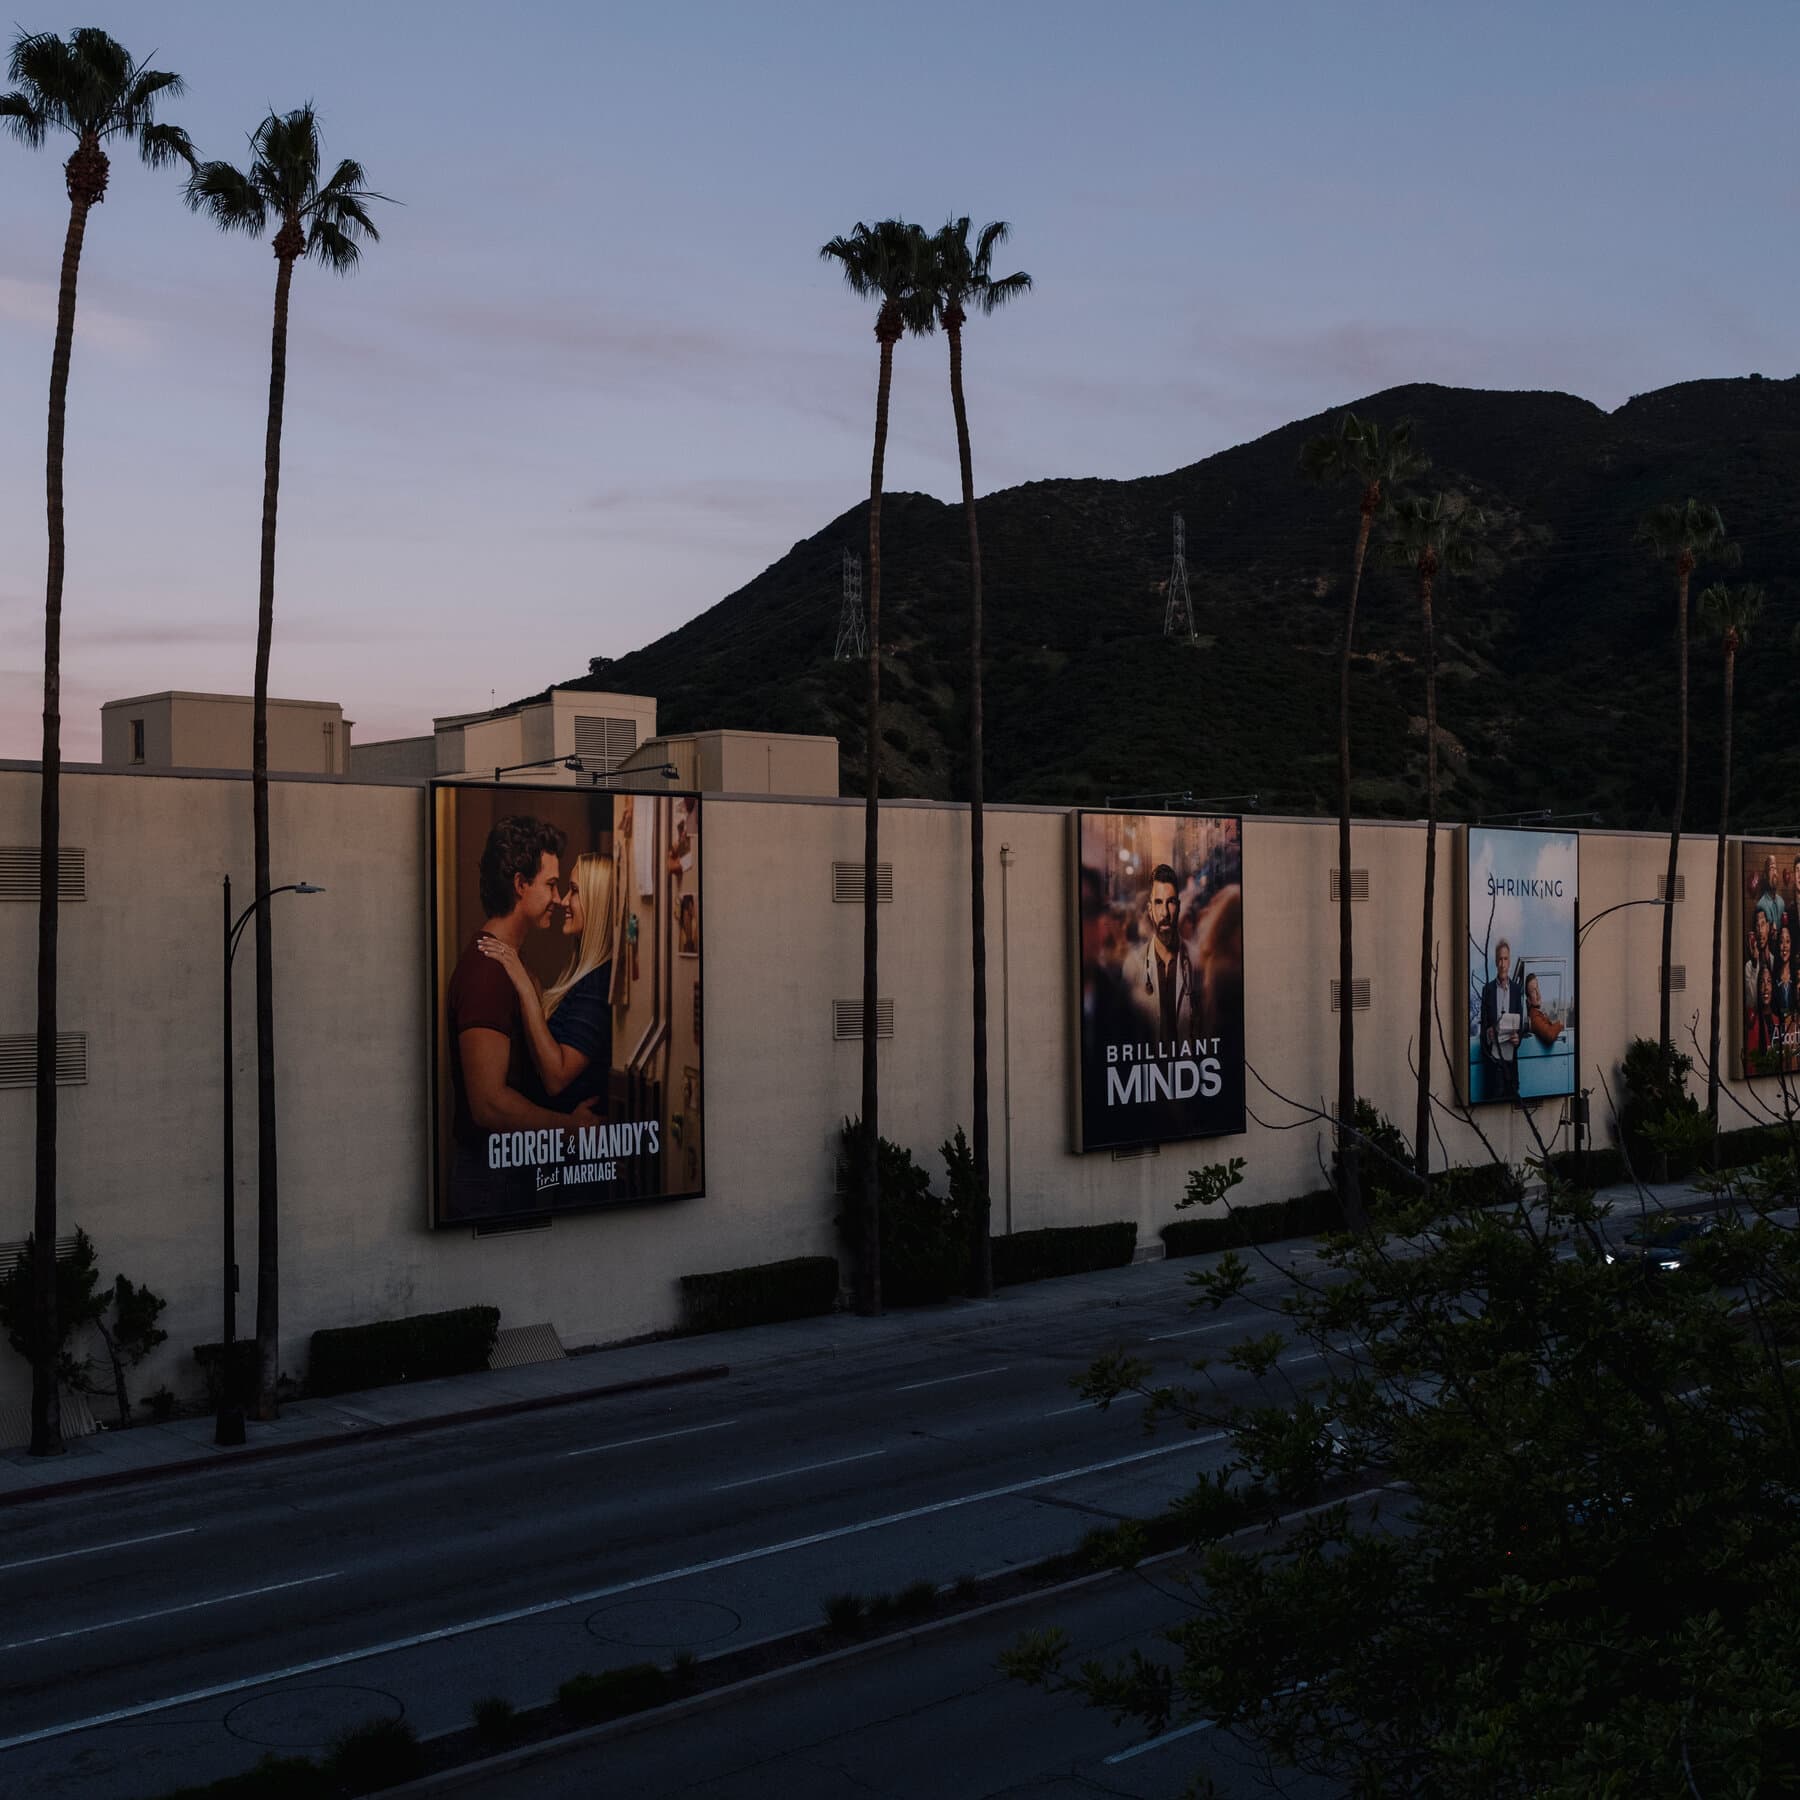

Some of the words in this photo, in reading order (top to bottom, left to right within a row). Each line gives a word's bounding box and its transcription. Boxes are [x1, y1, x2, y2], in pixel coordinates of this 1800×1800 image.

[1106, 1037, 1221, 1063] BRILLIANT
[1107, 1057, 1222, 1106] MINDS
[488, 1128, 565, 1169] GEORGIE
[566, 1135, 576, 1154] &
[579, 1120, 659, 1161] MANDY'S
[536, 1167, 560, 1190] first
[563, 1161, 617, 1185] MARRIAGE
